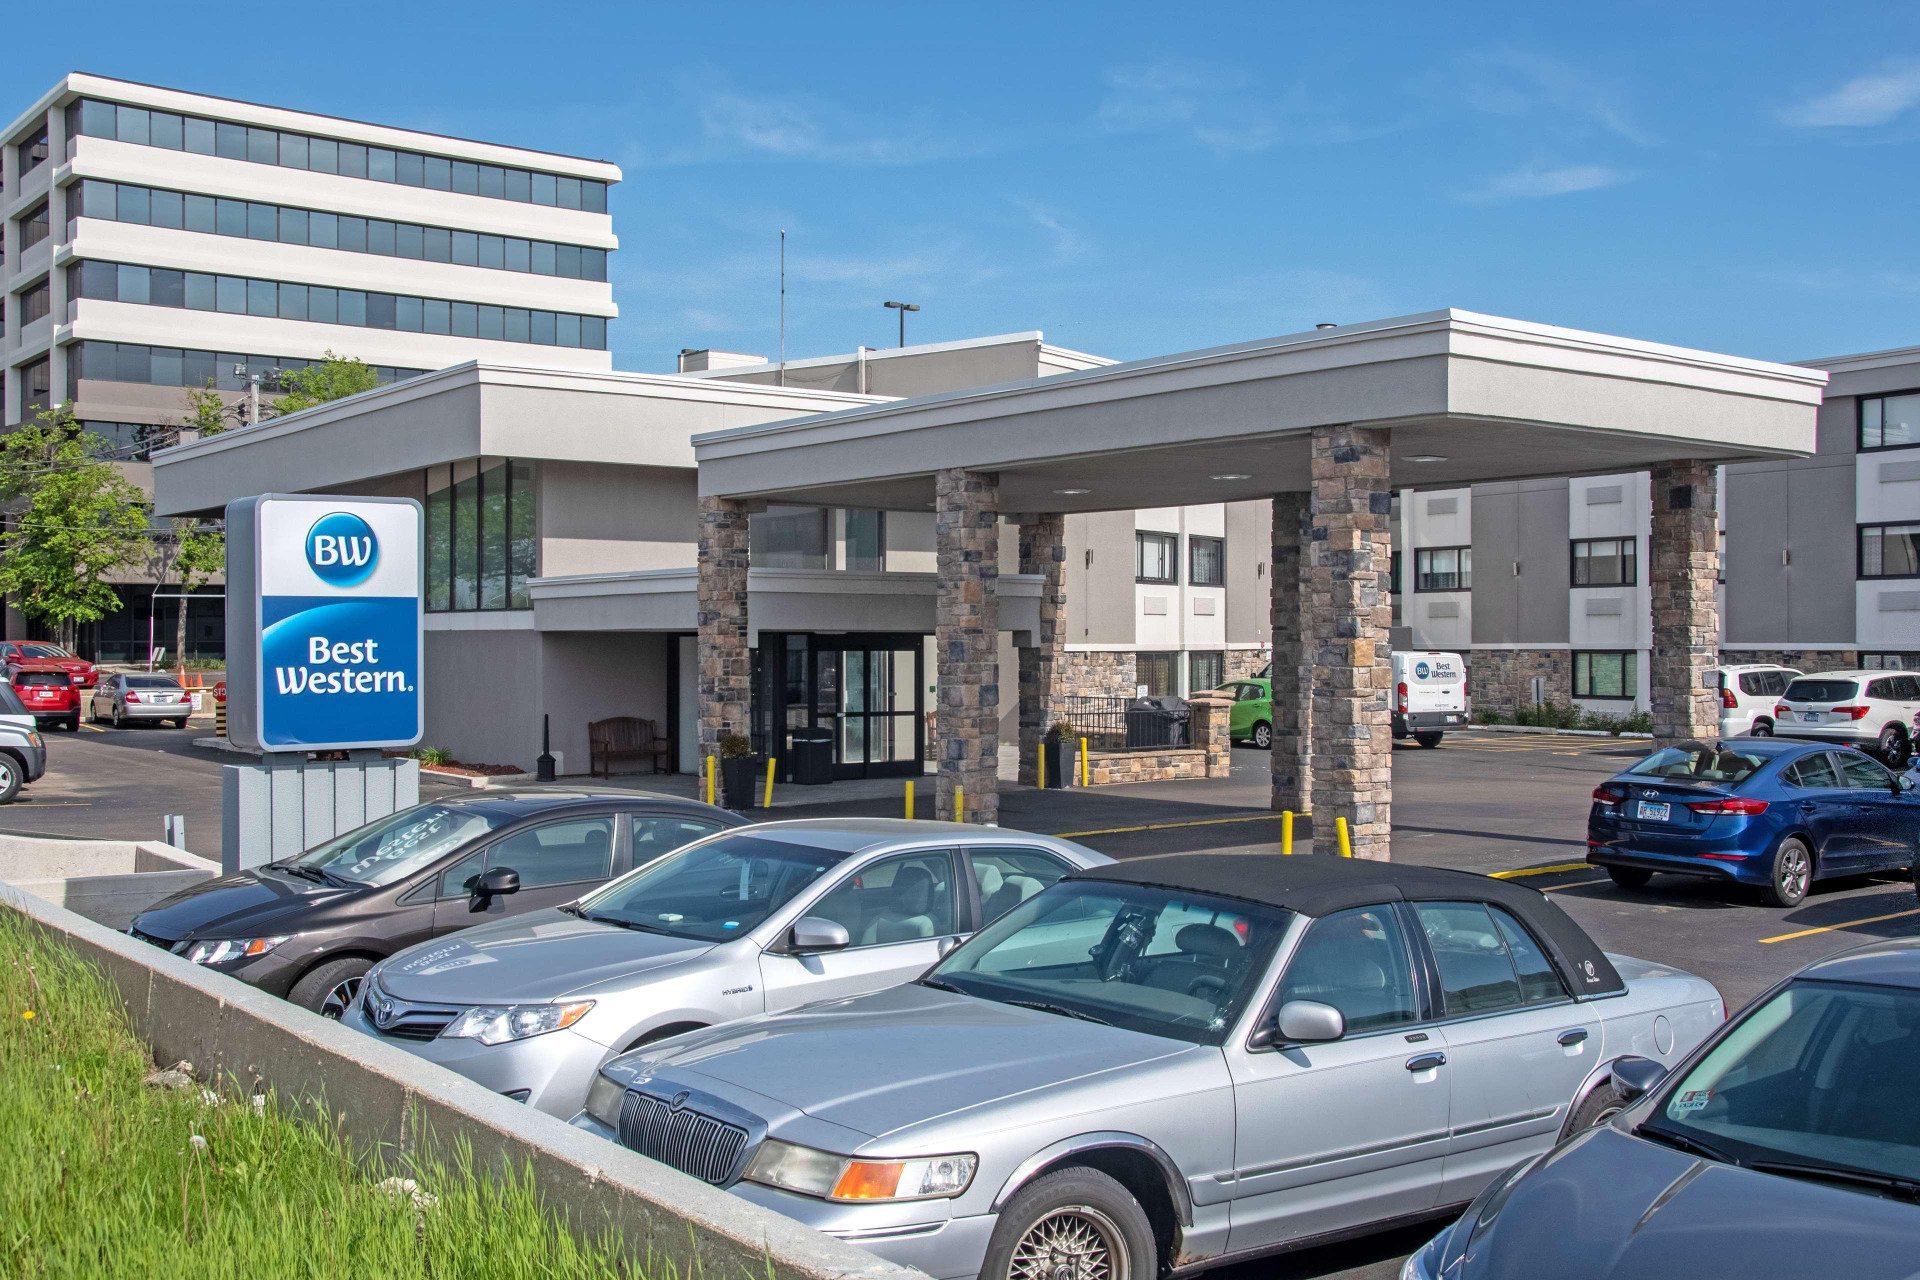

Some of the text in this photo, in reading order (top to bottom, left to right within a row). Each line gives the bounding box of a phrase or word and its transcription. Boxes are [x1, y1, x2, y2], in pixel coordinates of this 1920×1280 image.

[314, 535, 372, 567] BW
[309, 636, 379, 664] Best
[1416, 666, 1429, 675] BW
[1436, 662, 1451, 670] Best
[1431, 670, 1457, 678] Western
[213, 688, 227, 697] STO
[722, 986, 748, 996] HYBRID
